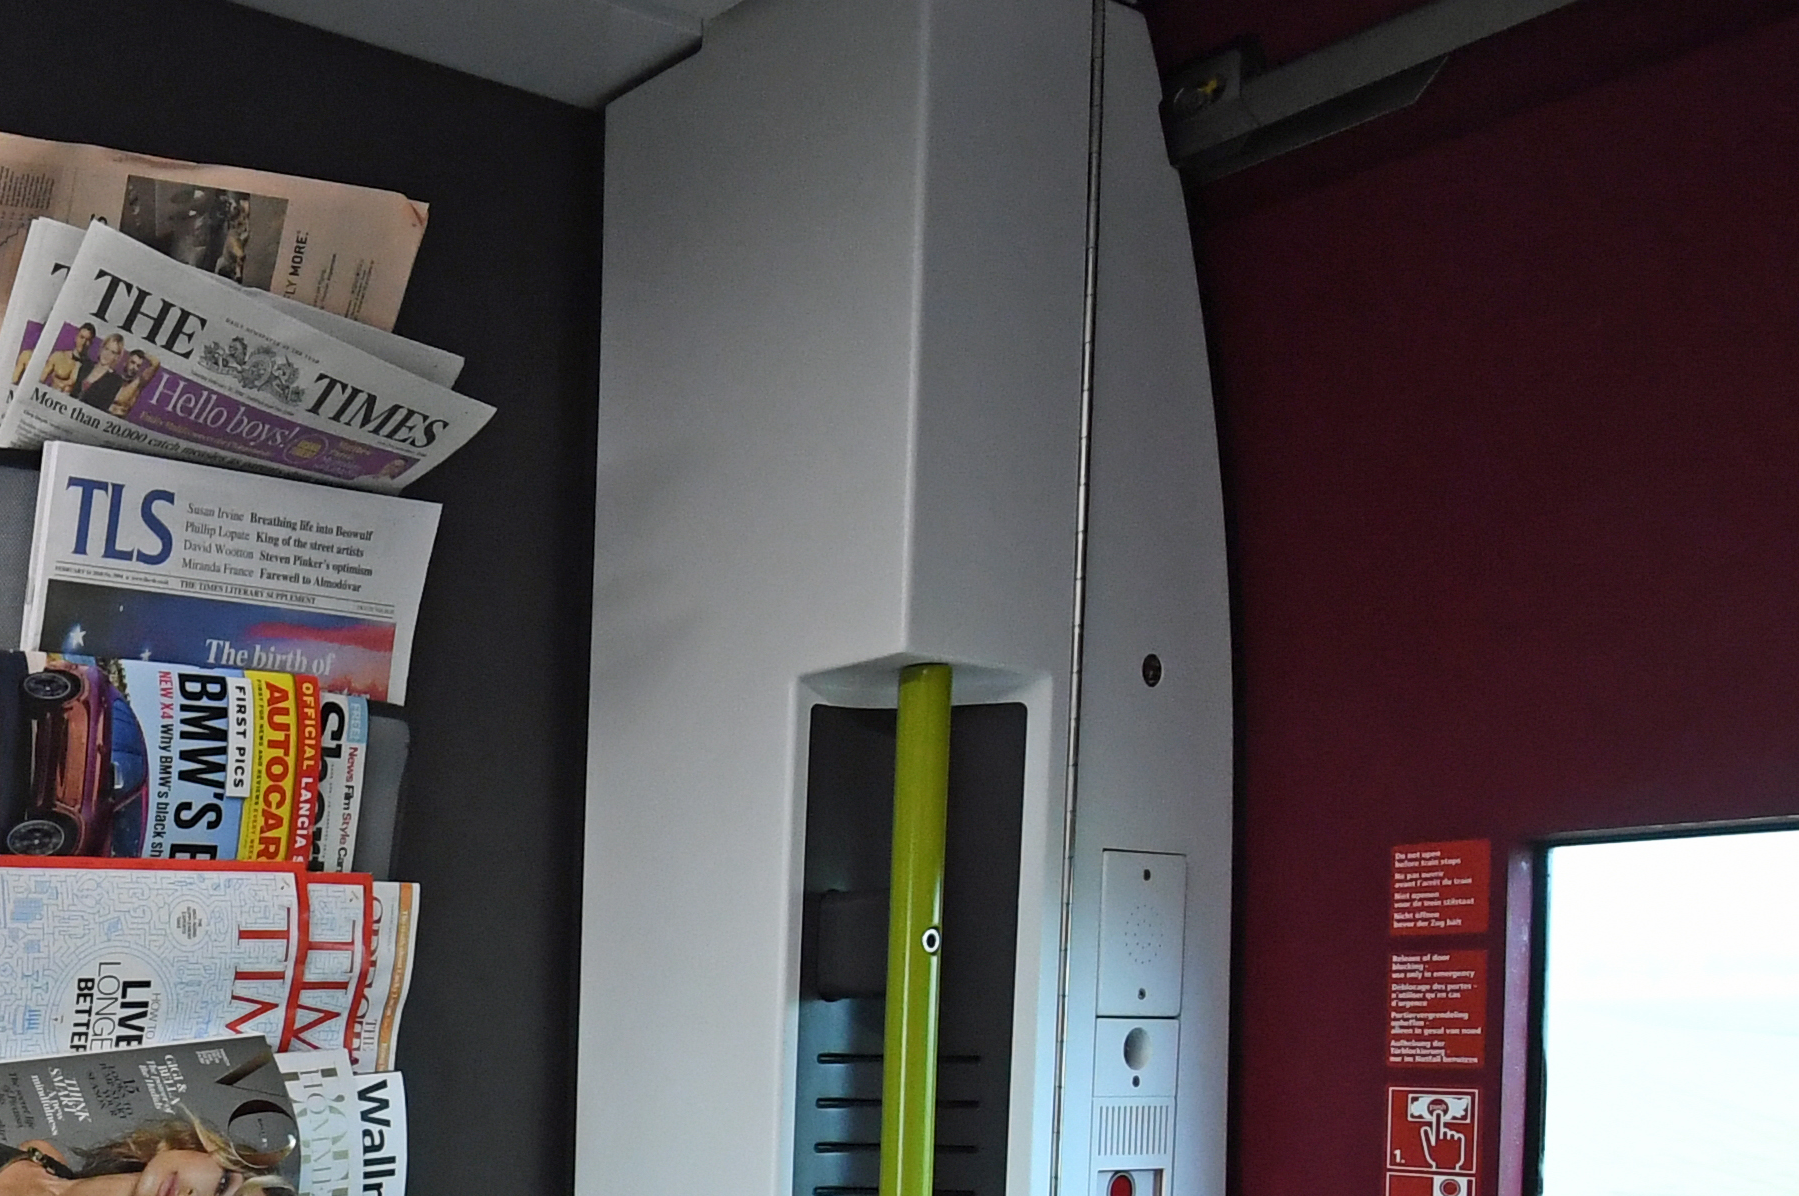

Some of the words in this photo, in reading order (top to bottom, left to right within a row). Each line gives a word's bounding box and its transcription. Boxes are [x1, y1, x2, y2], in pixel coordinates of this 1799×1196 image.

[89, 268, 208, 359] THE
[305, 372, 449, 448] TIMES
[30, 386, 68, 416] More
[70, 406, 101, 429] than
[102, 420, 149, 443] 20,000
[147, 435, 181, 452] catch
[150, 371, 228, 427] Hello
[226, 404, 300, 448] boys!
[66, 475, 175, 566] TLS
[187, 503, 215, 517] Susan
[217, 507, 244, 522] Irvine
[250, 512, 297, 531] Breathing
[299, 519, 314, 532] life
[316, 522, 333, 535] into
[336, 525, 374, 542] Beowulf
[183, 539, 212, 554] David
[259, 550, 290, 564] Steven
[332, 561, 373, 576] optimism
[219, 526, 250, 542] Lopate
[256, 532, 279, 547] King
[282, 535, 292, 547] of
[294, 537, 307, 549] the
[310, 539, 334, 554] street
[336, 543, 364, 558] artists
[182, 558, 221, 573] Miranda
[224, 563, 254, 578] France
[260, 568, 300, 584] Farewell
[302, 574, 311, 585] to
[199, 582, 223, 593] TIMES
[224, 585, 263, 599] LITERARY
[267, 590, 316, 604] SUPPLEMENT
[206, 639, 248, 666] The
[253, 645, 308, 674] birth
[312, 653, 336, 676] of
[158, 671, 173, 698] NEW
[160, 702, 173, 719] X4
[234, 685, 247, 740] FIRST
[302, 682, 316, 770] OFFICIAL
[159, 723, 174, 752] Why
[173, 673, 228, 830] BMW'S
[158, 756, 173, 798] BMW's
[233, 746, 246, 789] PICS
[256, 681, 290, 861] AUTOCAR
[346, 746, 358, 782] News
[295, 777, 313, 848] LANCIA
[342, 785, 354, 810] Film
[153, 802, 169, 838] black
[339, 813, 352, 845] Style
[115, 980, 152, 1048] LIVE
[150, 993, 161, 1022] HOW
[146, 1024, 157, 1039] TO
[362, 1019, 378, 1051] THE
[49, 1067, 77, 1113] SMART
[157, 1065, 180, 1105] BELLA
[164, 1054, 184, 1081] GIGI
[176, 1083, 188, 1093] &
[31, 1074, 59, 1136] mindfulness
[64, 1078, 92, 1123] THINK
[1393, 1149, 1406, 1164] 1.
